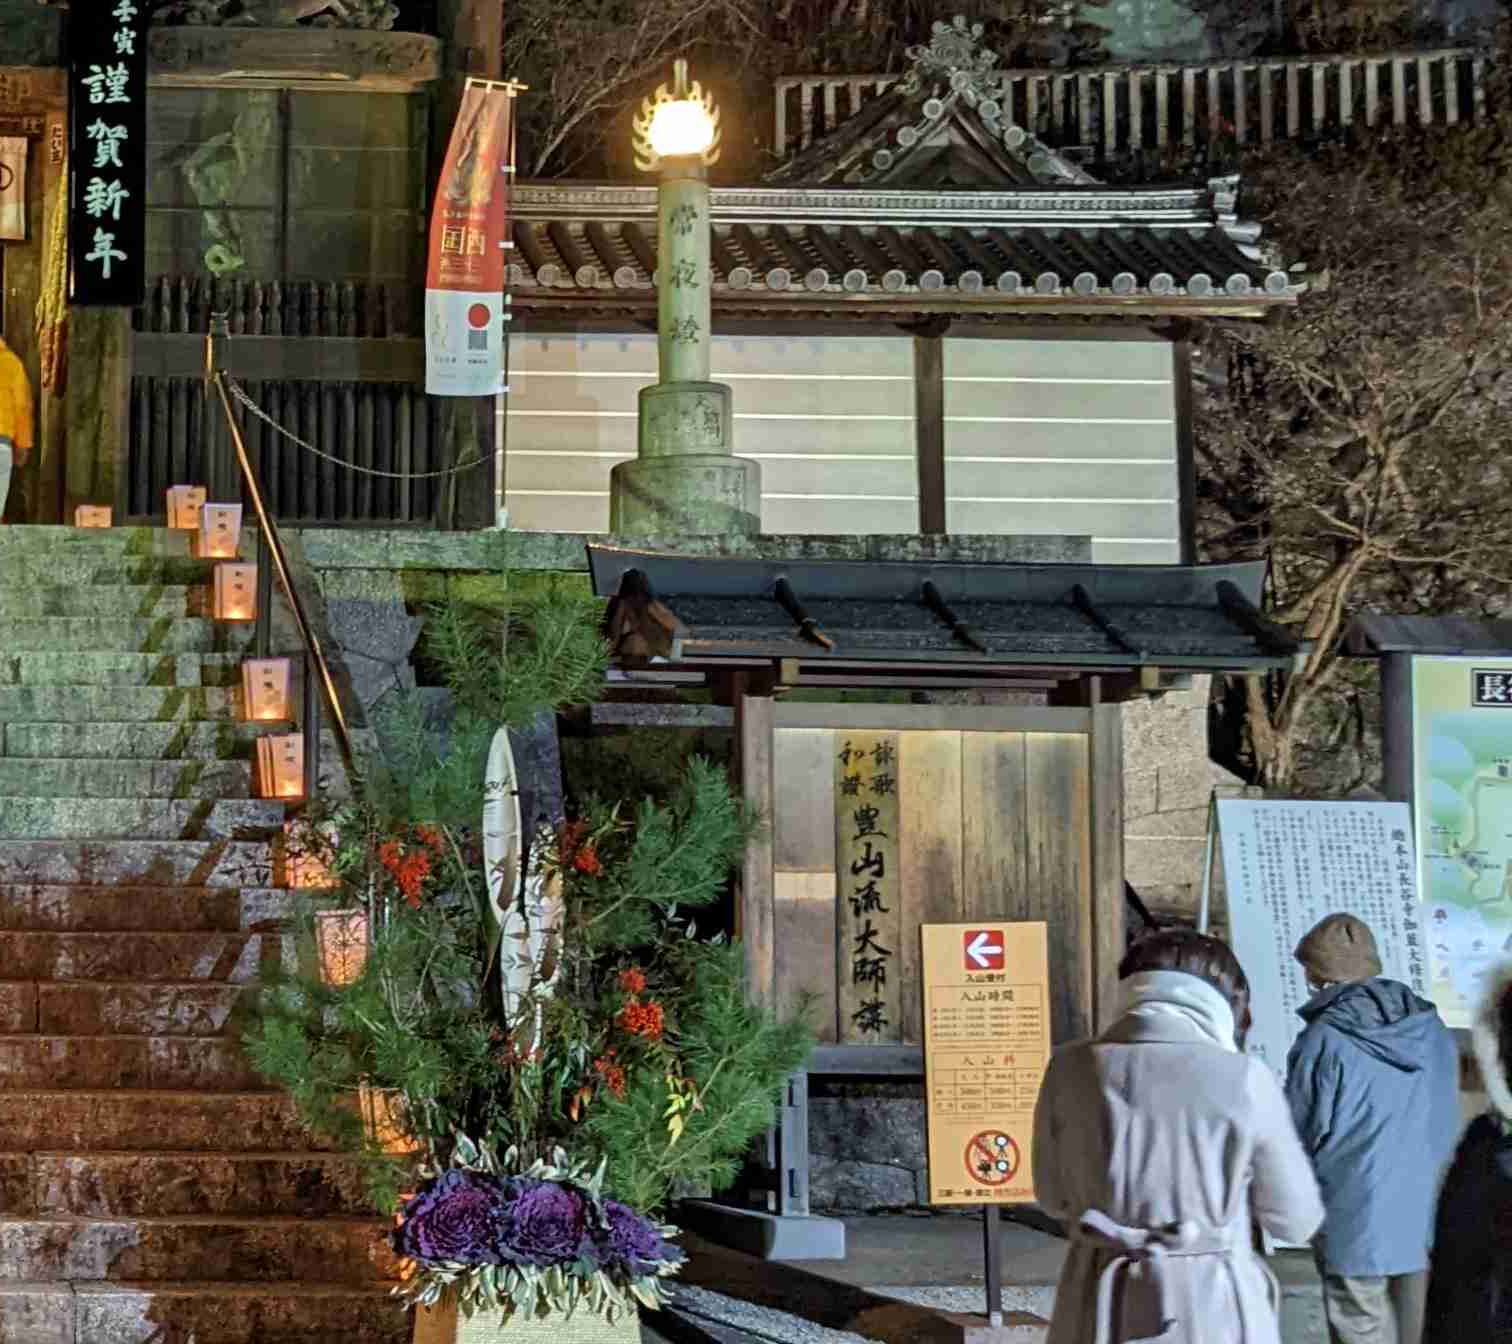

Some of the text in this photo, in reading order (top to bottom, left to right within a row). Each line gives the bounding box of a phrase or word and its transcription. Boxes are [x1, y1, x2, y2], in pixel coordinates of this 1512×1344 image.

[80, 61, 132, 280] 謹賀新年
[1480, 675, 1512, 701] 長
